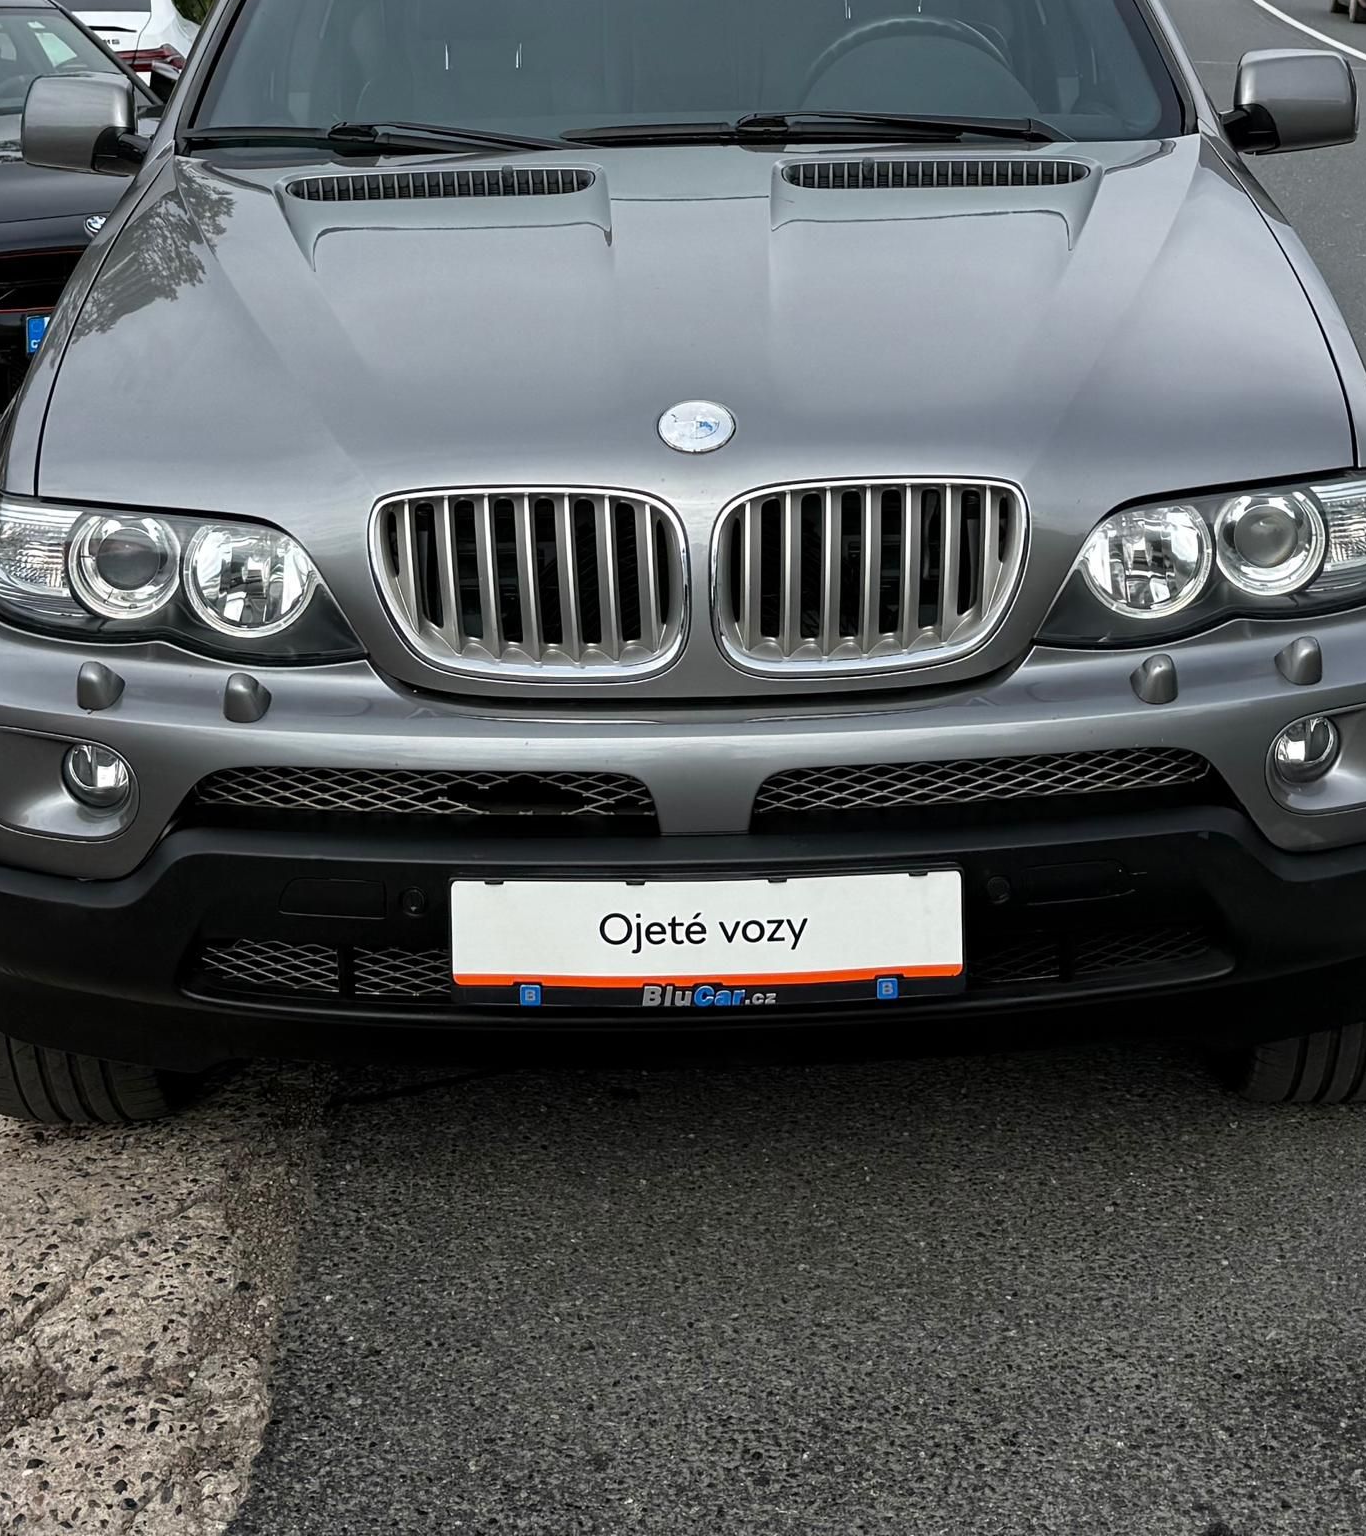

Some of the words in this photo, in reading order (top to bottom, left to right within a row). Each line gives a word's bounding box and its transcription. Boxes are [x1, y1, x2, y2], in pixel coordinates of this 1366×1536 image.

[599, 912, 707, 954] Ojeté
[718, 917, 808, 951] vozy
[642, 984, 777, 1007] BluCar.cz
